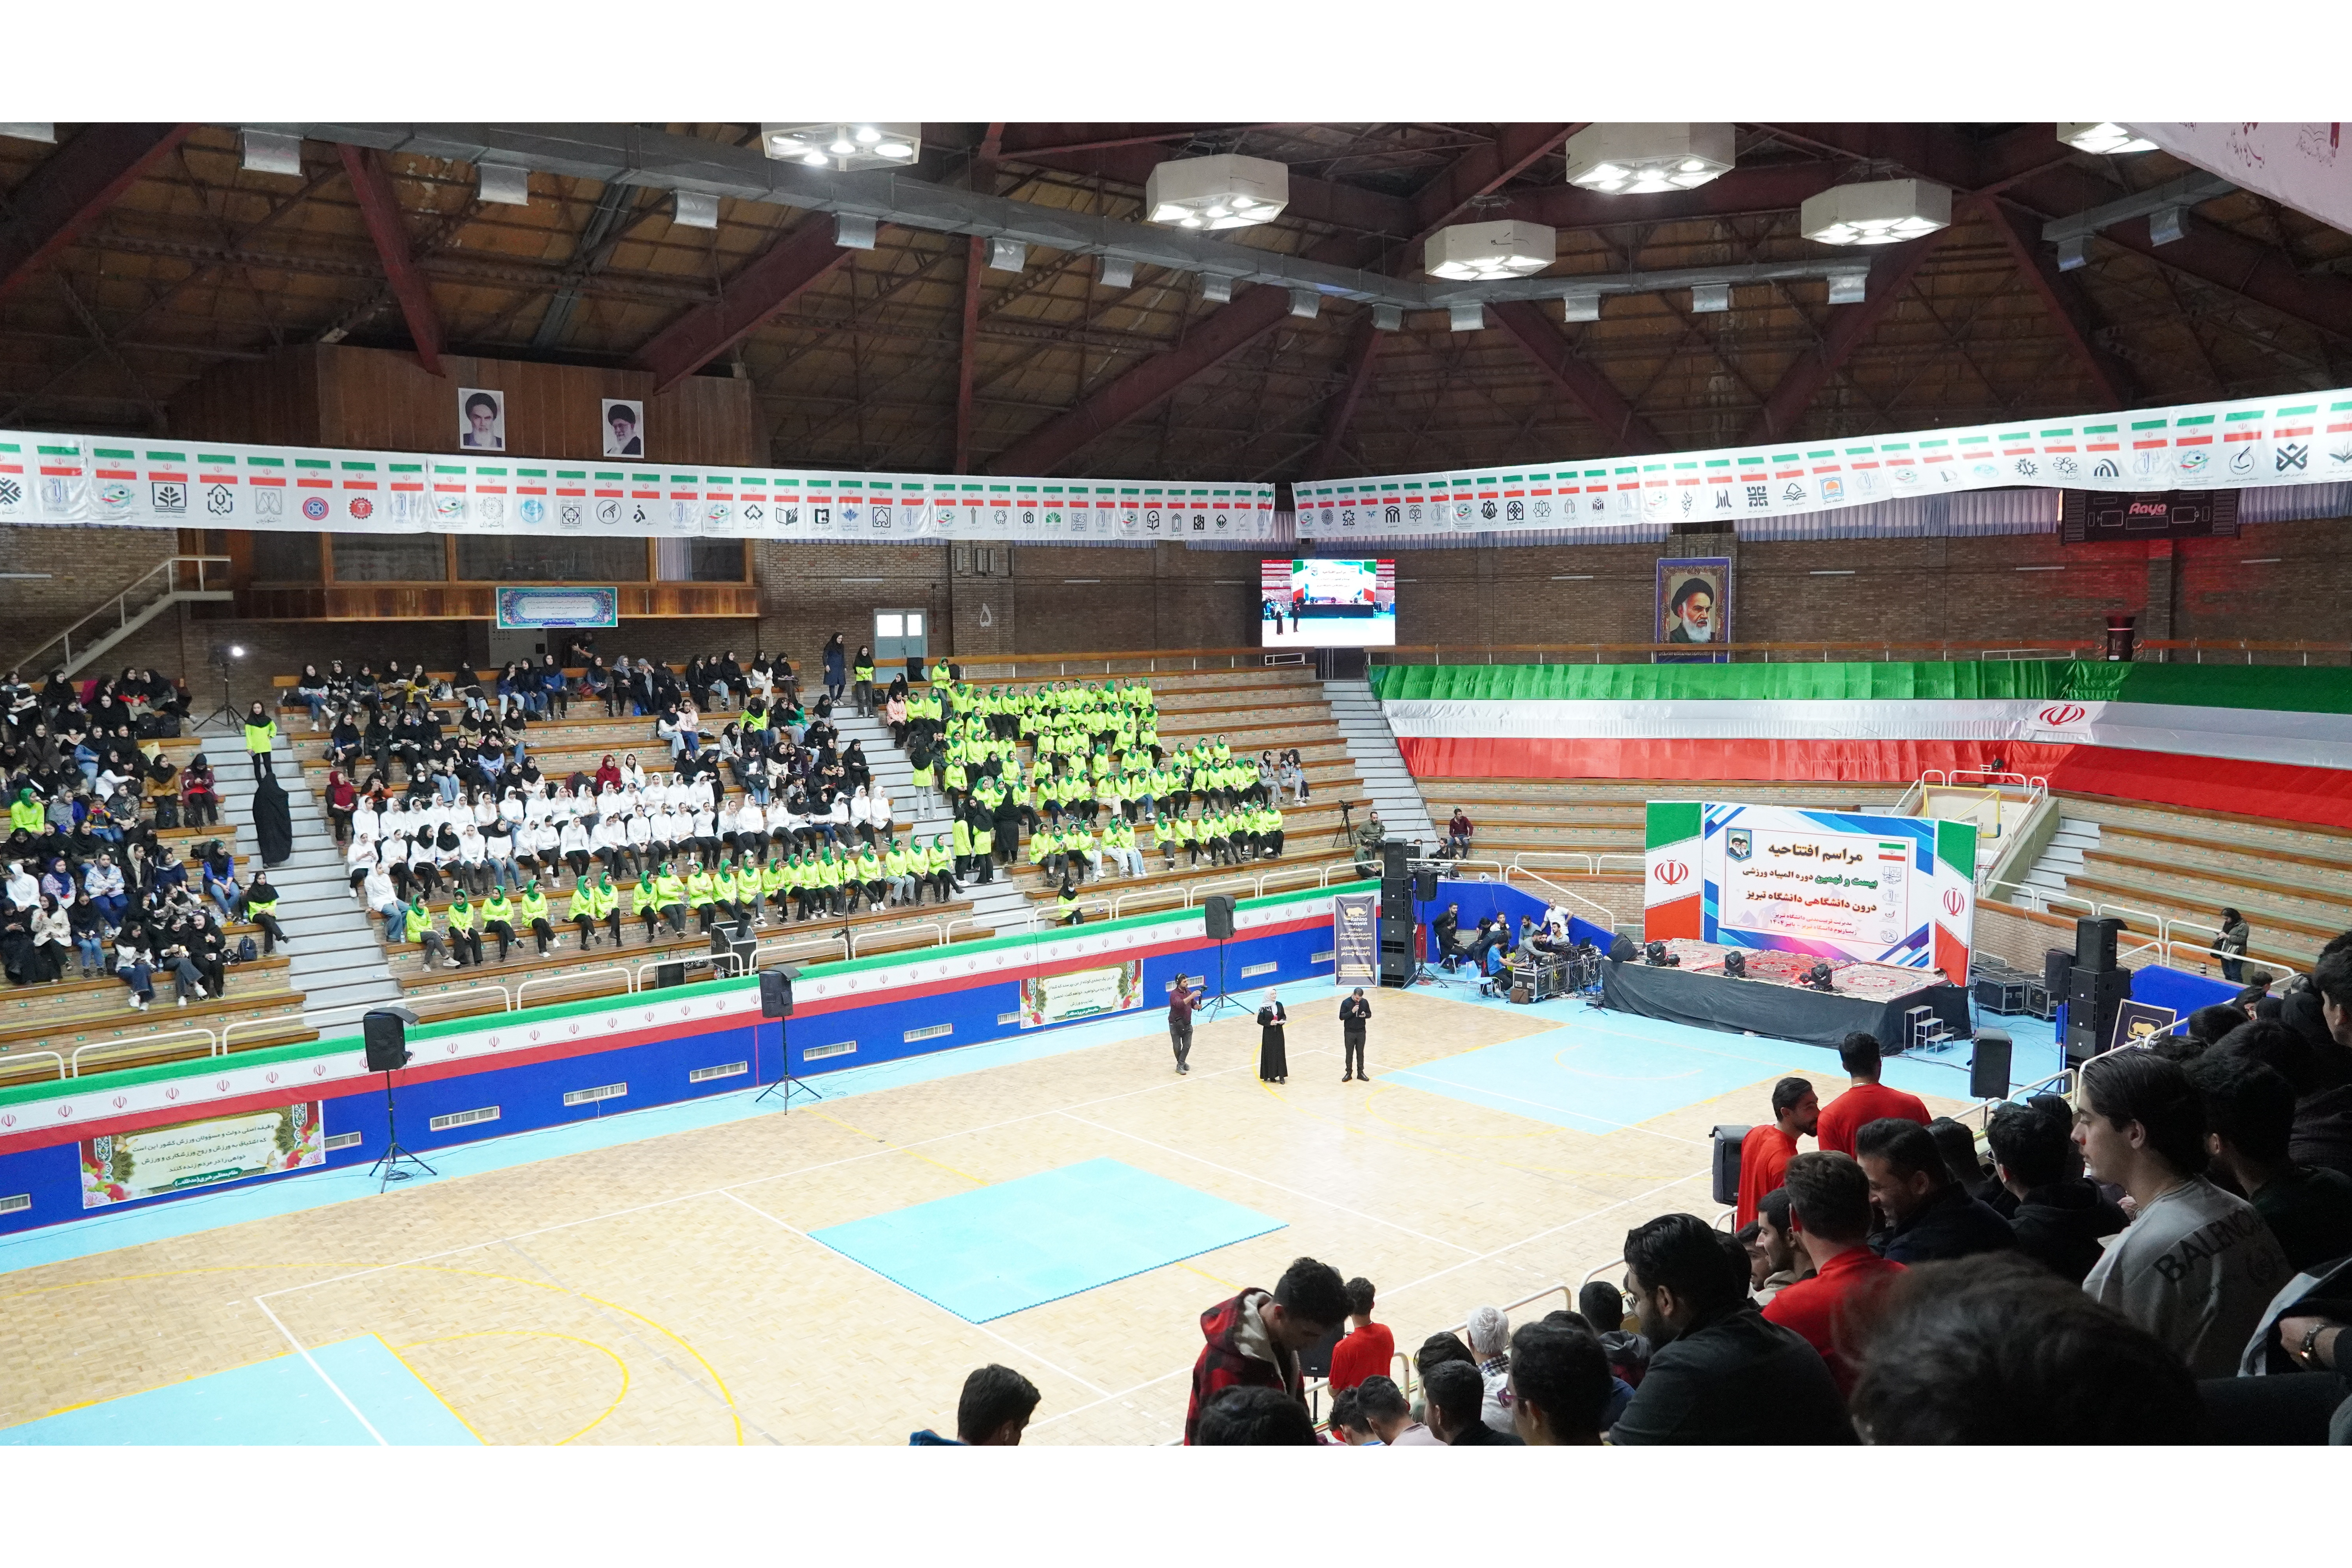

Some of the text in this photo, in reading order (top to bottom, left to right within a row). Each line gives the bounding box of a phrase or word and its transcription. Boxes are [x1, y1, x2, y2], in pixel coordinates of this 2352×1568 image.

[1768, 843, 1864, 865] مراسم افتتاحیه
[1742, 866, 1878, 890] بیست و نهمین دوره المپیاد ورزشی
[1745, 890, 1877, 913] درون دانشگاهی دانشگاه تبریز
[2136, 1035, 2158, 1046] Rano
[241, 1127, 257, 1135] اصلی
[160, 1140, 176, 1149] کشور
[176, 1138, 195, 1146] ورزش
[166, 1151, 196, 1161] ورزشکاری
